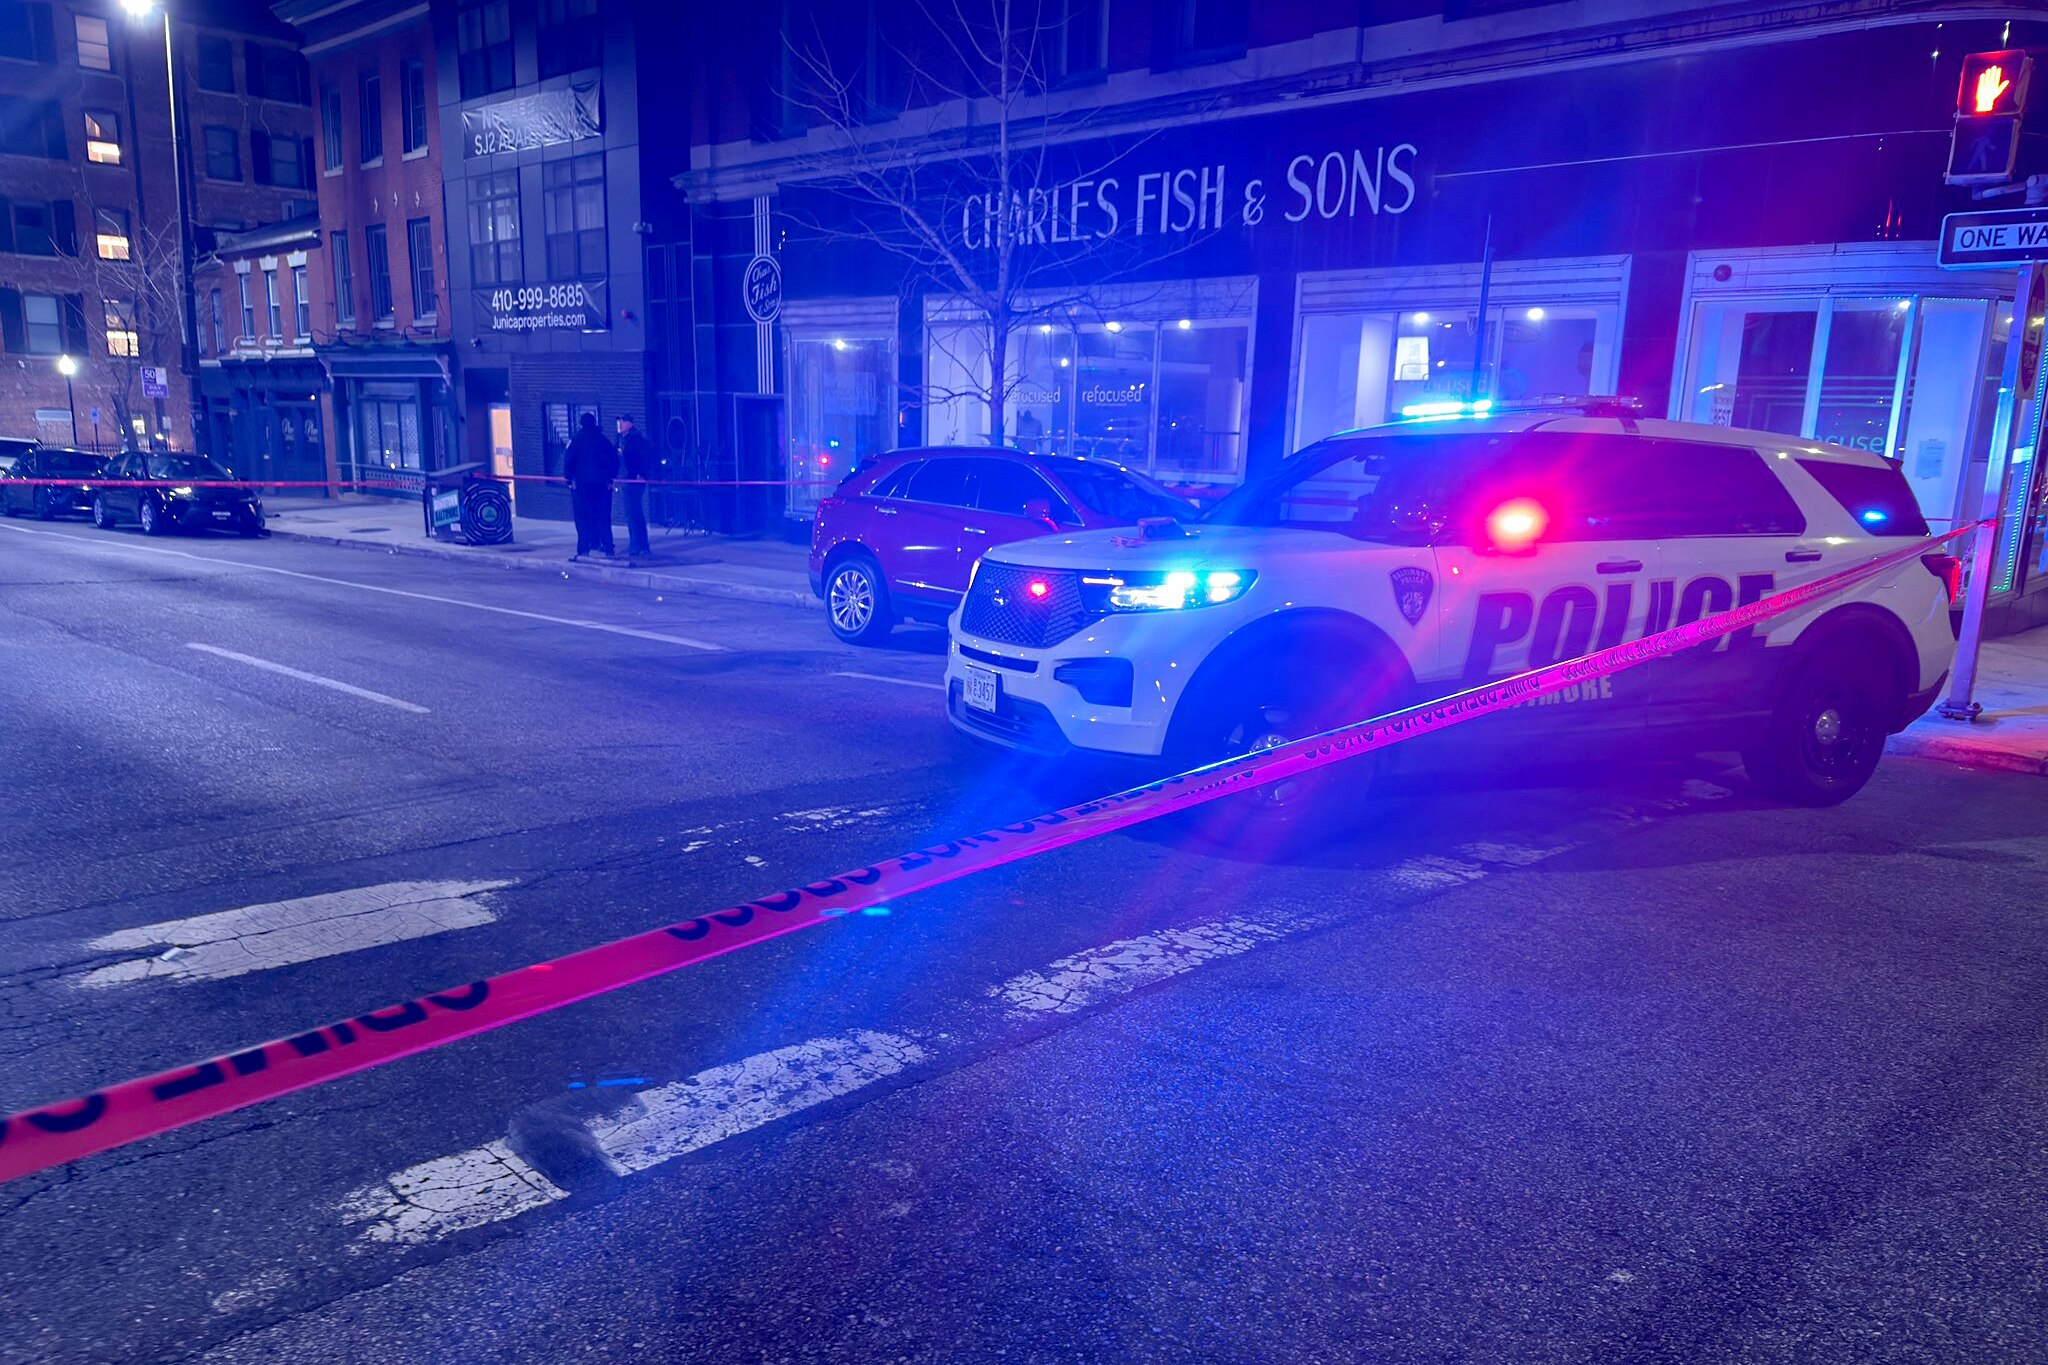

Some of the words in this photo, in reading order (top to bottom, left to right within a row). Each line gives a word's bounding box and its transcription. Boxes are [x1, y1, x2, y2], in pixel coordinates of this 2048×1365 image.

[474, 131, 496, 156] SJ2
[962, 177, 1119, 251] CHARLES
[1135, 164, 1227, 238] FISH
[1242, 178, 1266, 227] &
[1284, 142, 1418, 224] SONS
[1960, 227, 2008, 249] ONE
[491, 283, 584, 313] 410-999-8685
[751, 272, 777, 305] Fish
[492, 311, 586, 331] Junicaproperties.com
[1009, 386, 1061, 403] efocused
[1081, 384, 1142, 403] refocused
[1465, 571, 1775, 677] POLICE
[977, 680, 994, 702] 3457
